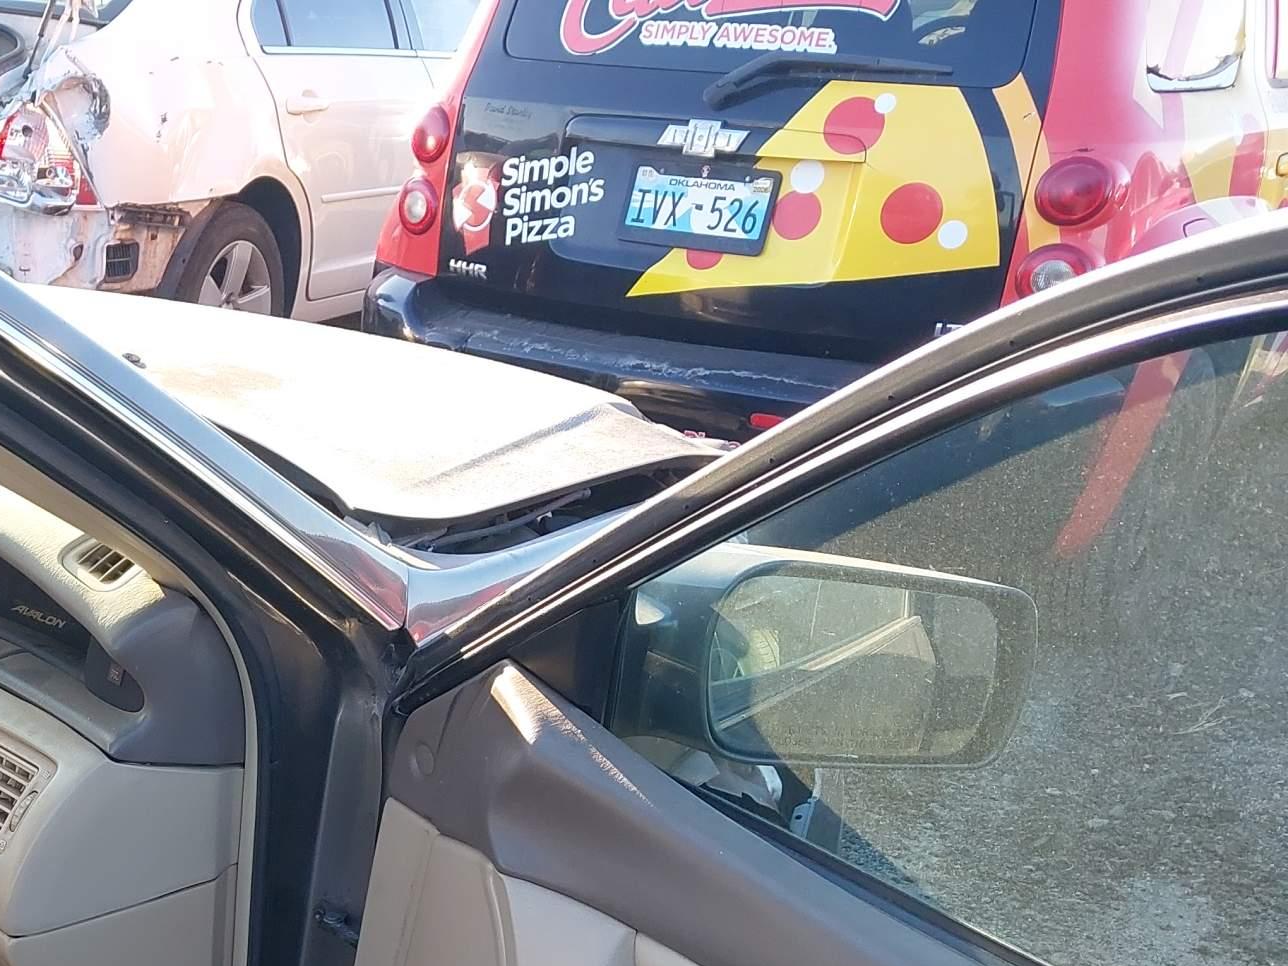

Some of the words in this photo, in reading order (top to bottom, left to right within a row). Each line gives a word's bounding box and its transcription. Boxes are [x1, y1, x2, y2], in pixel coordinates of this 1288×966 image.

[641, 22, 713, 42] SIMPLY
[716, 26, 833, 49] AWESOME.
[501, 146, 595, 187] Simple
[502, 178, 605, 217] Simon's
[669, 178, 736, 192] OKLAHOMA
[631, 189, 759, 234] IVX-526
[505, 215, 576, 246] Pizza
[449, 258, 488, 279] HHR
[10, 604, 67, 629] AVALON
